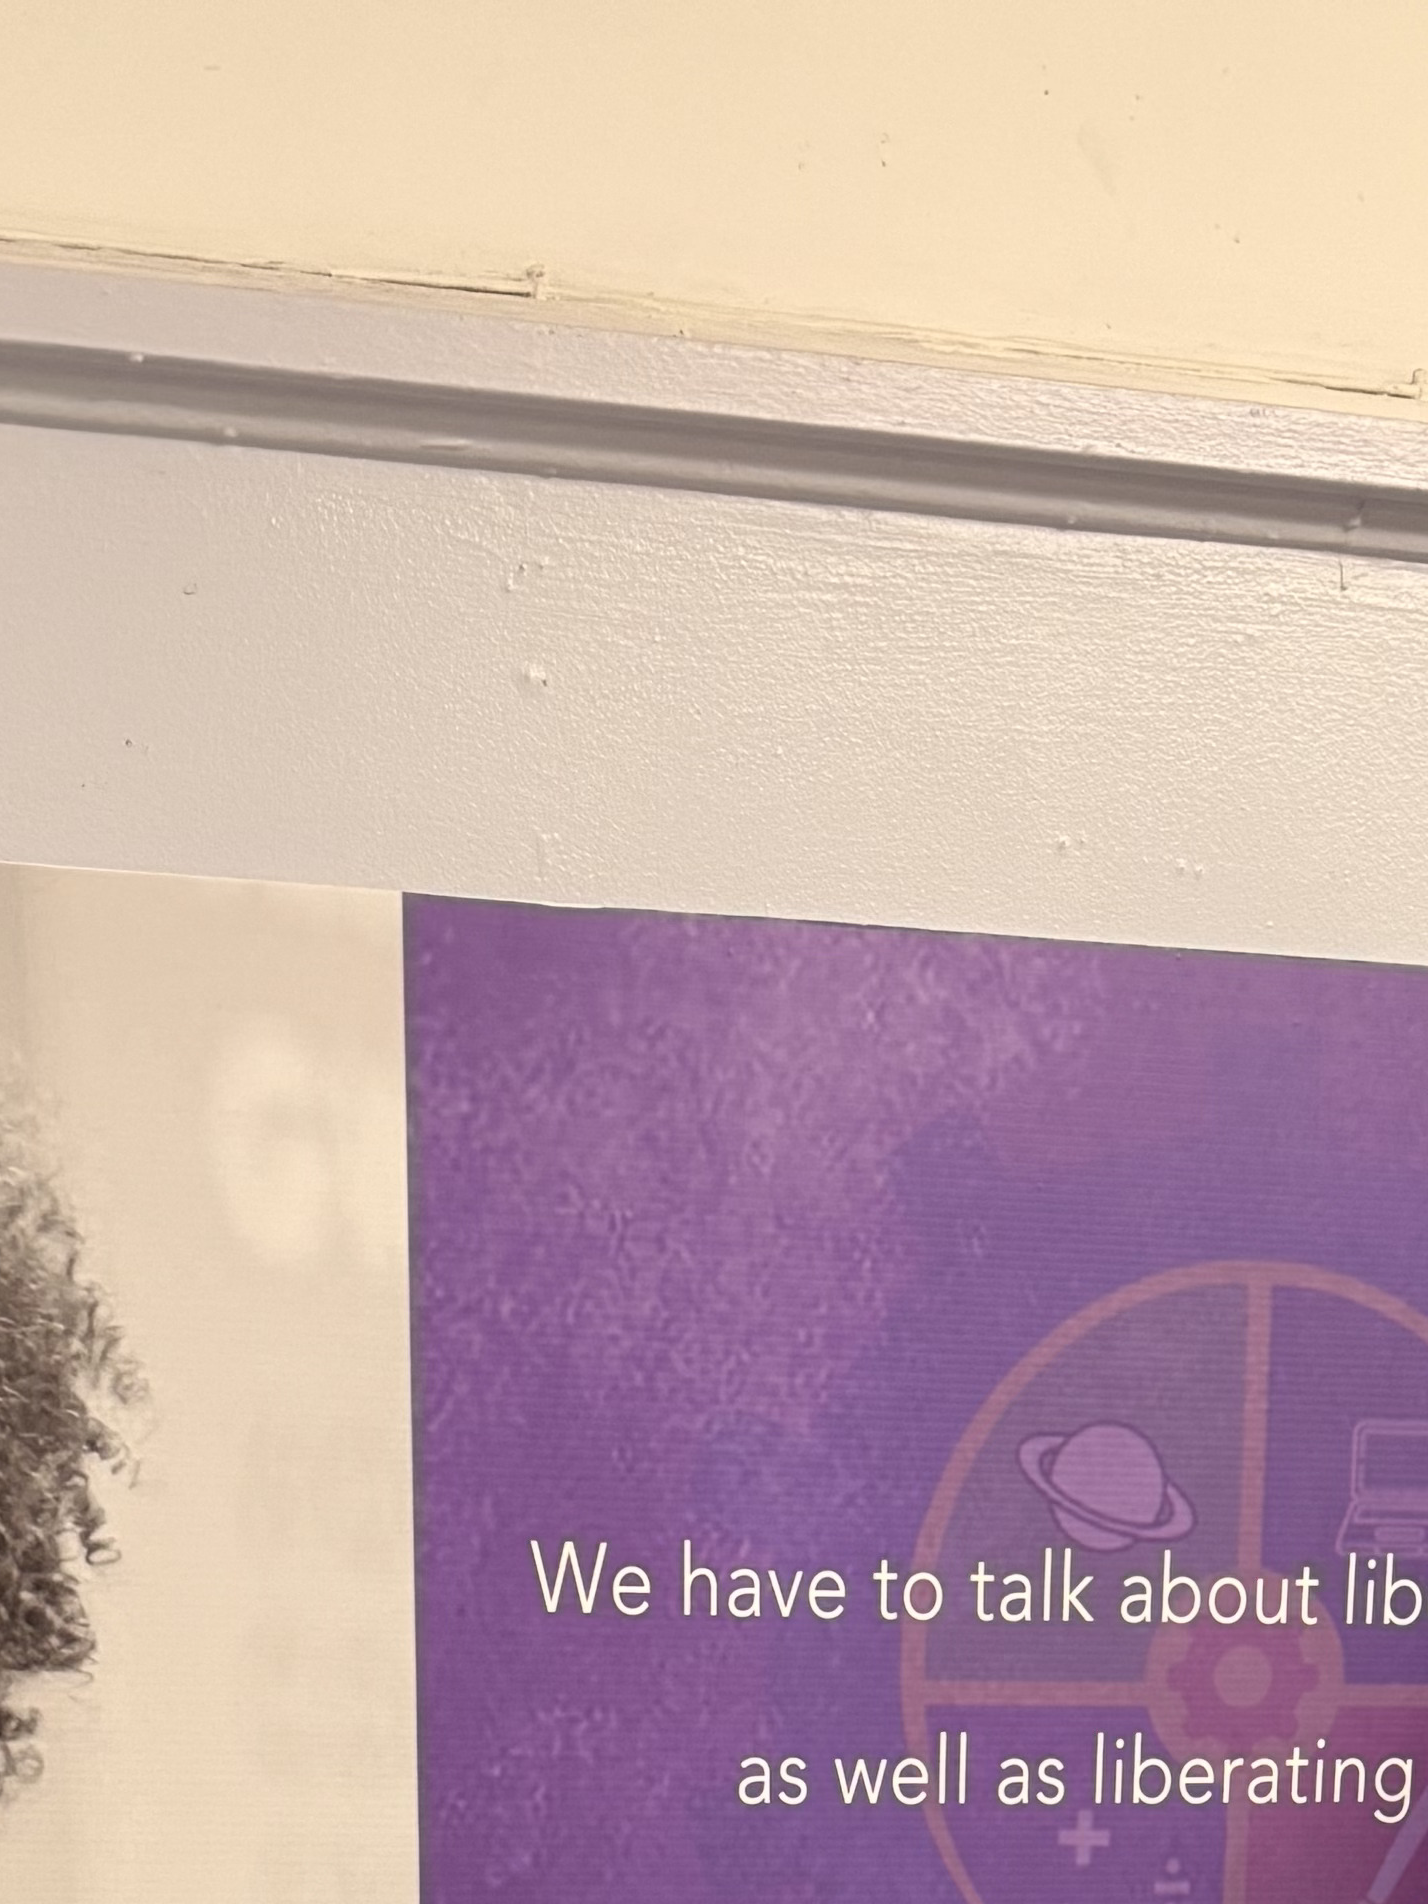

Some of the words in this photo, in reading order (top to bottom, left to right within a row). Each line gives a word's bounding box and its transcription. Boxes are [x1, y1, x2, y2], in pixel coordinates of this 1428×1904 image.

[529, 1538, 652, 1617] We
[682, 1538, 847, 1621] have
[871, 1558, 945, 1622] to
[968, 1546, 1096, 1624] talk
[1119, 1548, 1321, 1627] about
[737, 1755, 809, 1806] as
[833, 1730, 969, 1807] well
[996, 1756, 1066, 1807] as
[1093, 1730, 1414, 1825] liberating
